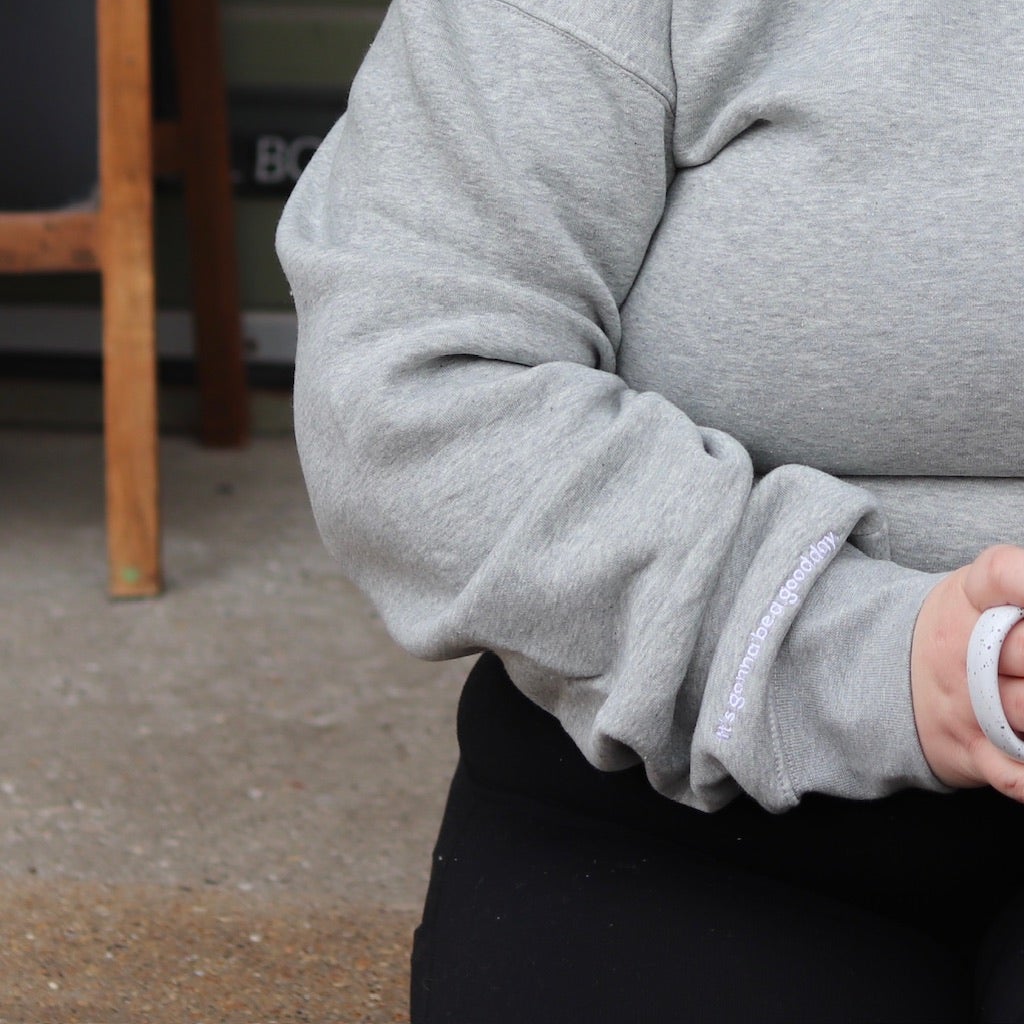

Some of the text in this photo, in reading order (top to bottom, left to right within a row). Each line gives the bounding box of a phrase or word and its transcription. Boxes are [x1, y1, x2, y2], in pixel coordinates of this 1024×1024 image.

[729, 641, 761, 709] gonna
[750, 615, 776, 641] be
[769, 600, 785, 616] a
[779, 555, 814, 605] good
